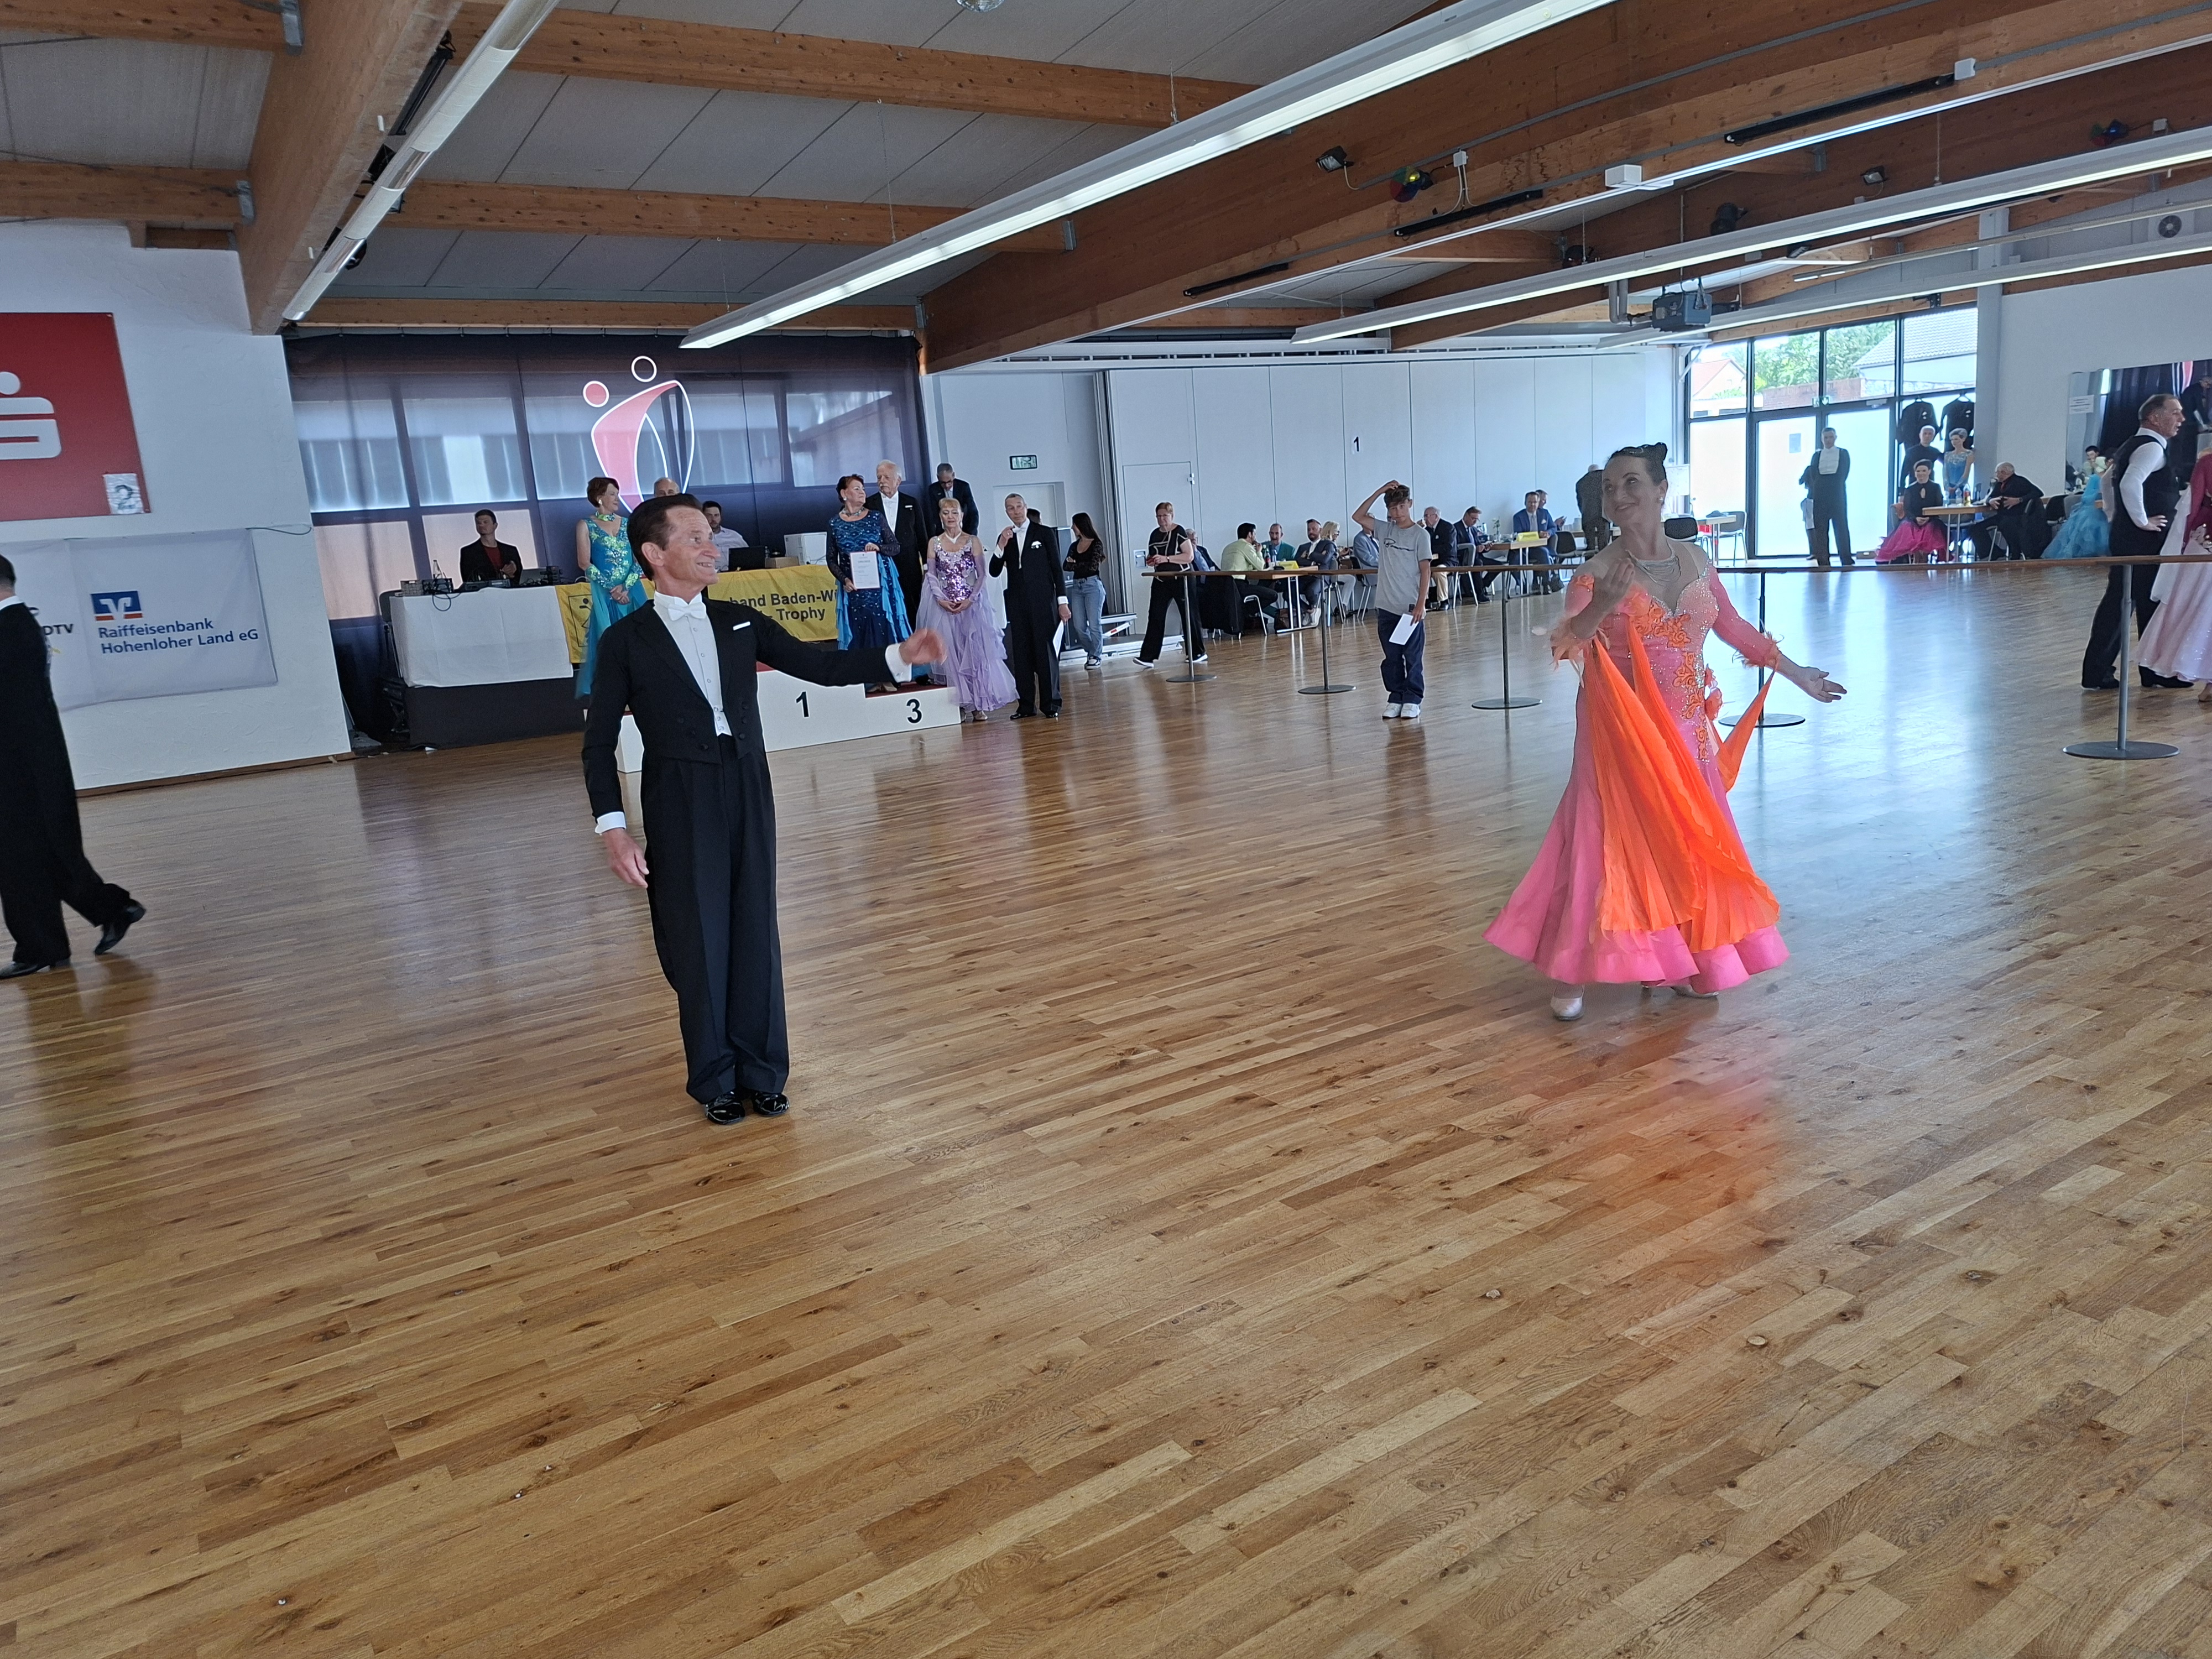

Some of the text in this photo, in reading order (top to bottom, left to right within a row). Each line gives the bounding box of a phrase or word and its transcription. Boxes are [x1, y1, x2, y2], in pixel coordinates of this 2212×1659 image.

[1354, 436, 1359, 452] 1
[114, 484, 136, 509] 2
[776, 607, 825, 622] Trophy
[43, 624, 74, 635] DTV
[98, 618, 213, 638] Raiffeisenbank
[101, 629, 259, 654] Hohenloher Land eG
[796, 691, 809, 717] 1
[906, 698, 922, 723] 3
